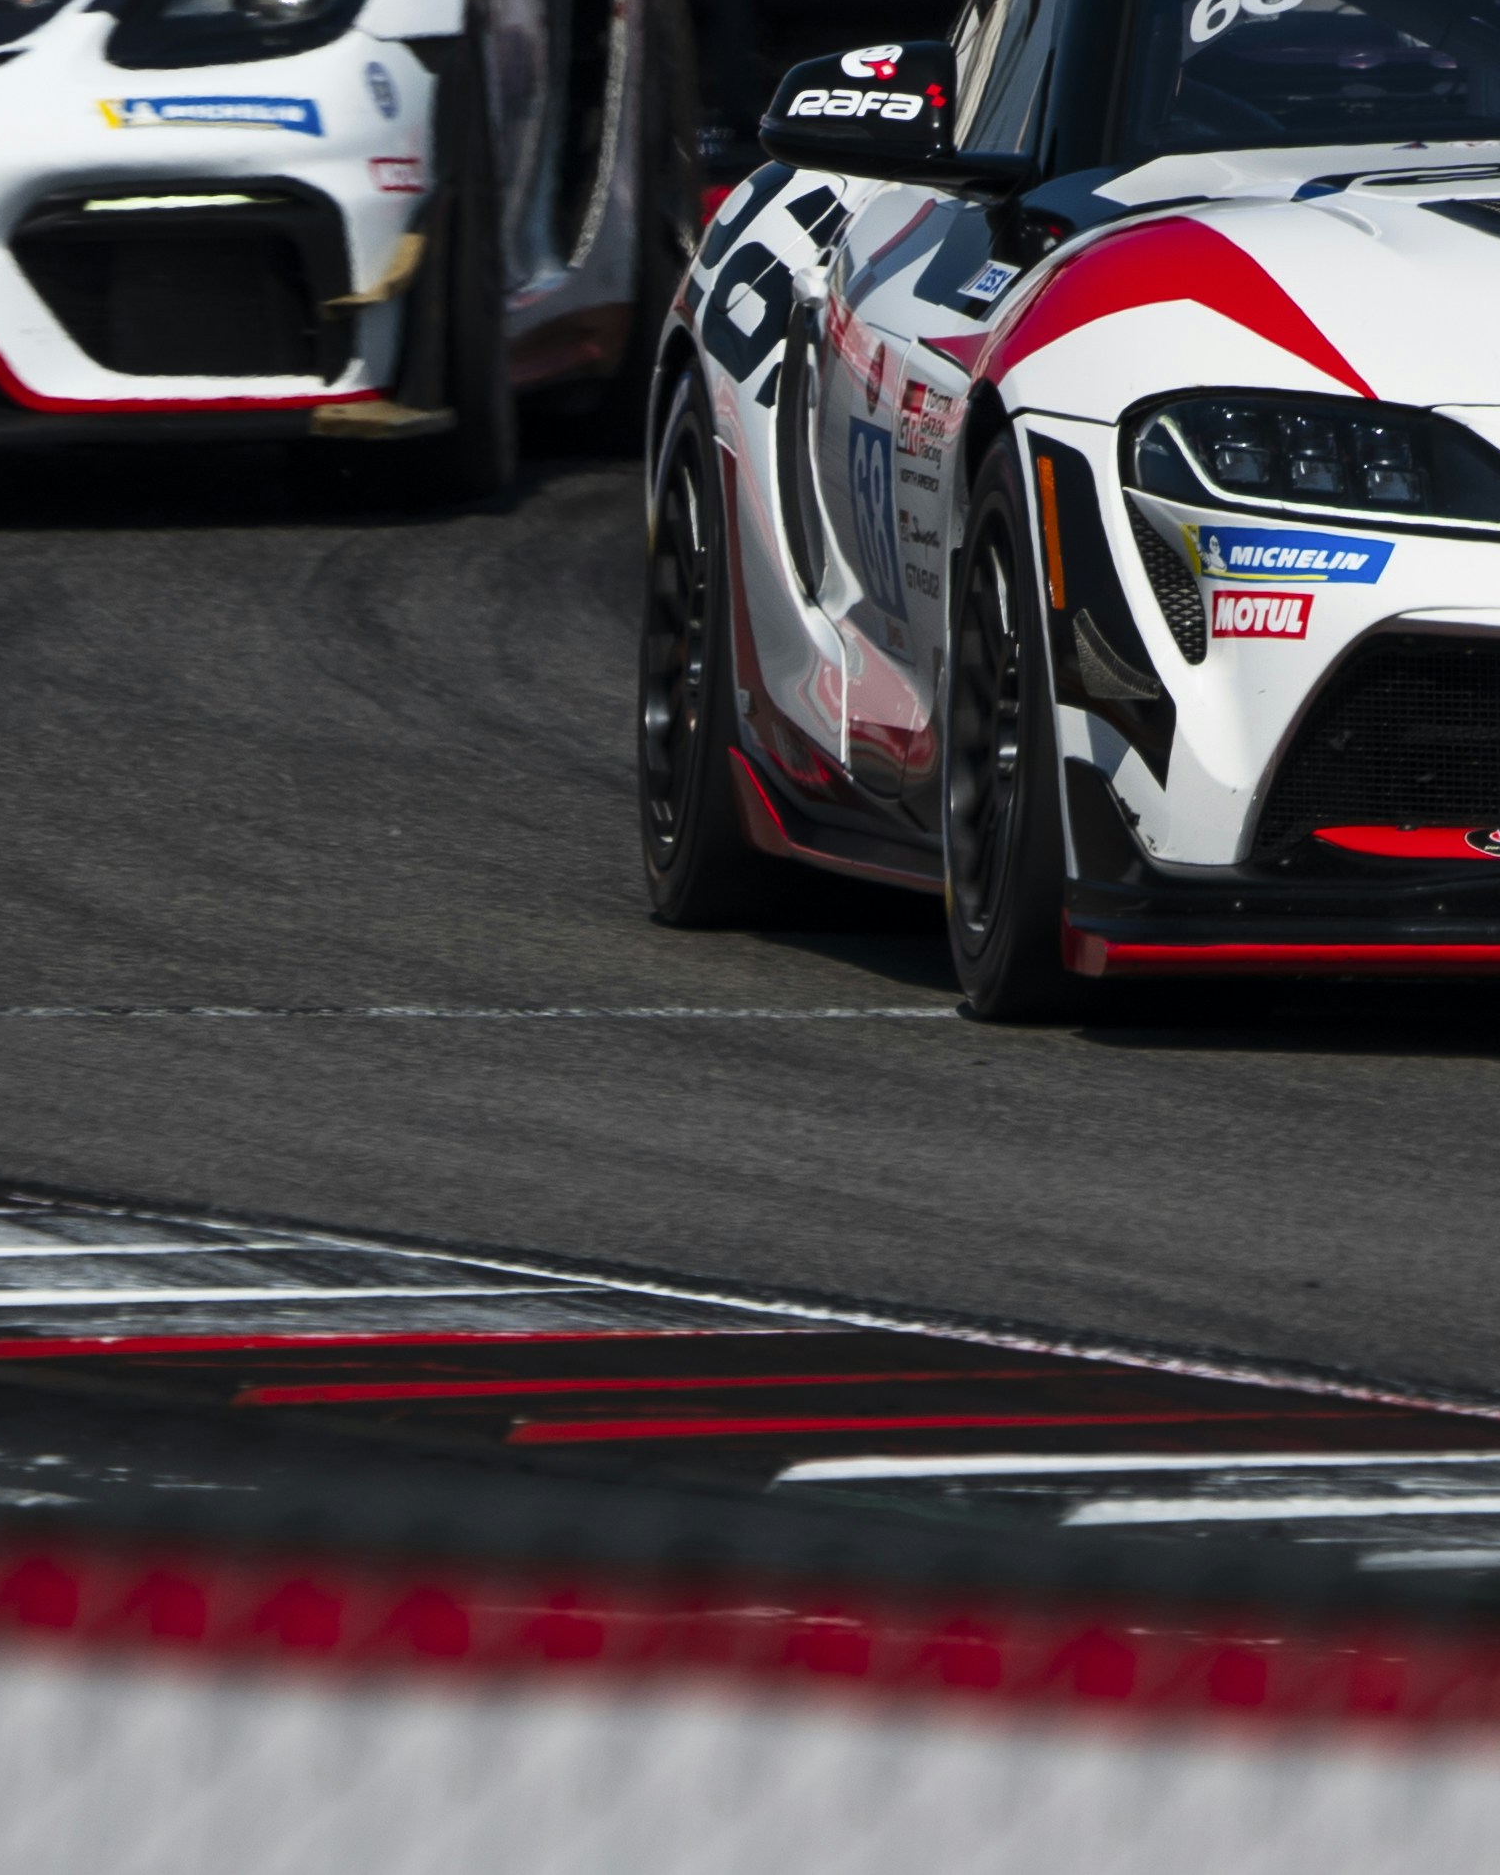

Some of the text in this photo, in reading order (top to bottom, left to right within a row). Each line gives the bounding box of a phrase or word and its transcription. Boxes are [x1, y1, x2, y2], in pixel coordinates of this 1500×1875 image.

[853, 431, 897, 606] 68
[1229, 545, 1370, 571] MICHELIN
[1214, 596, 1304, 634] MOTUL
